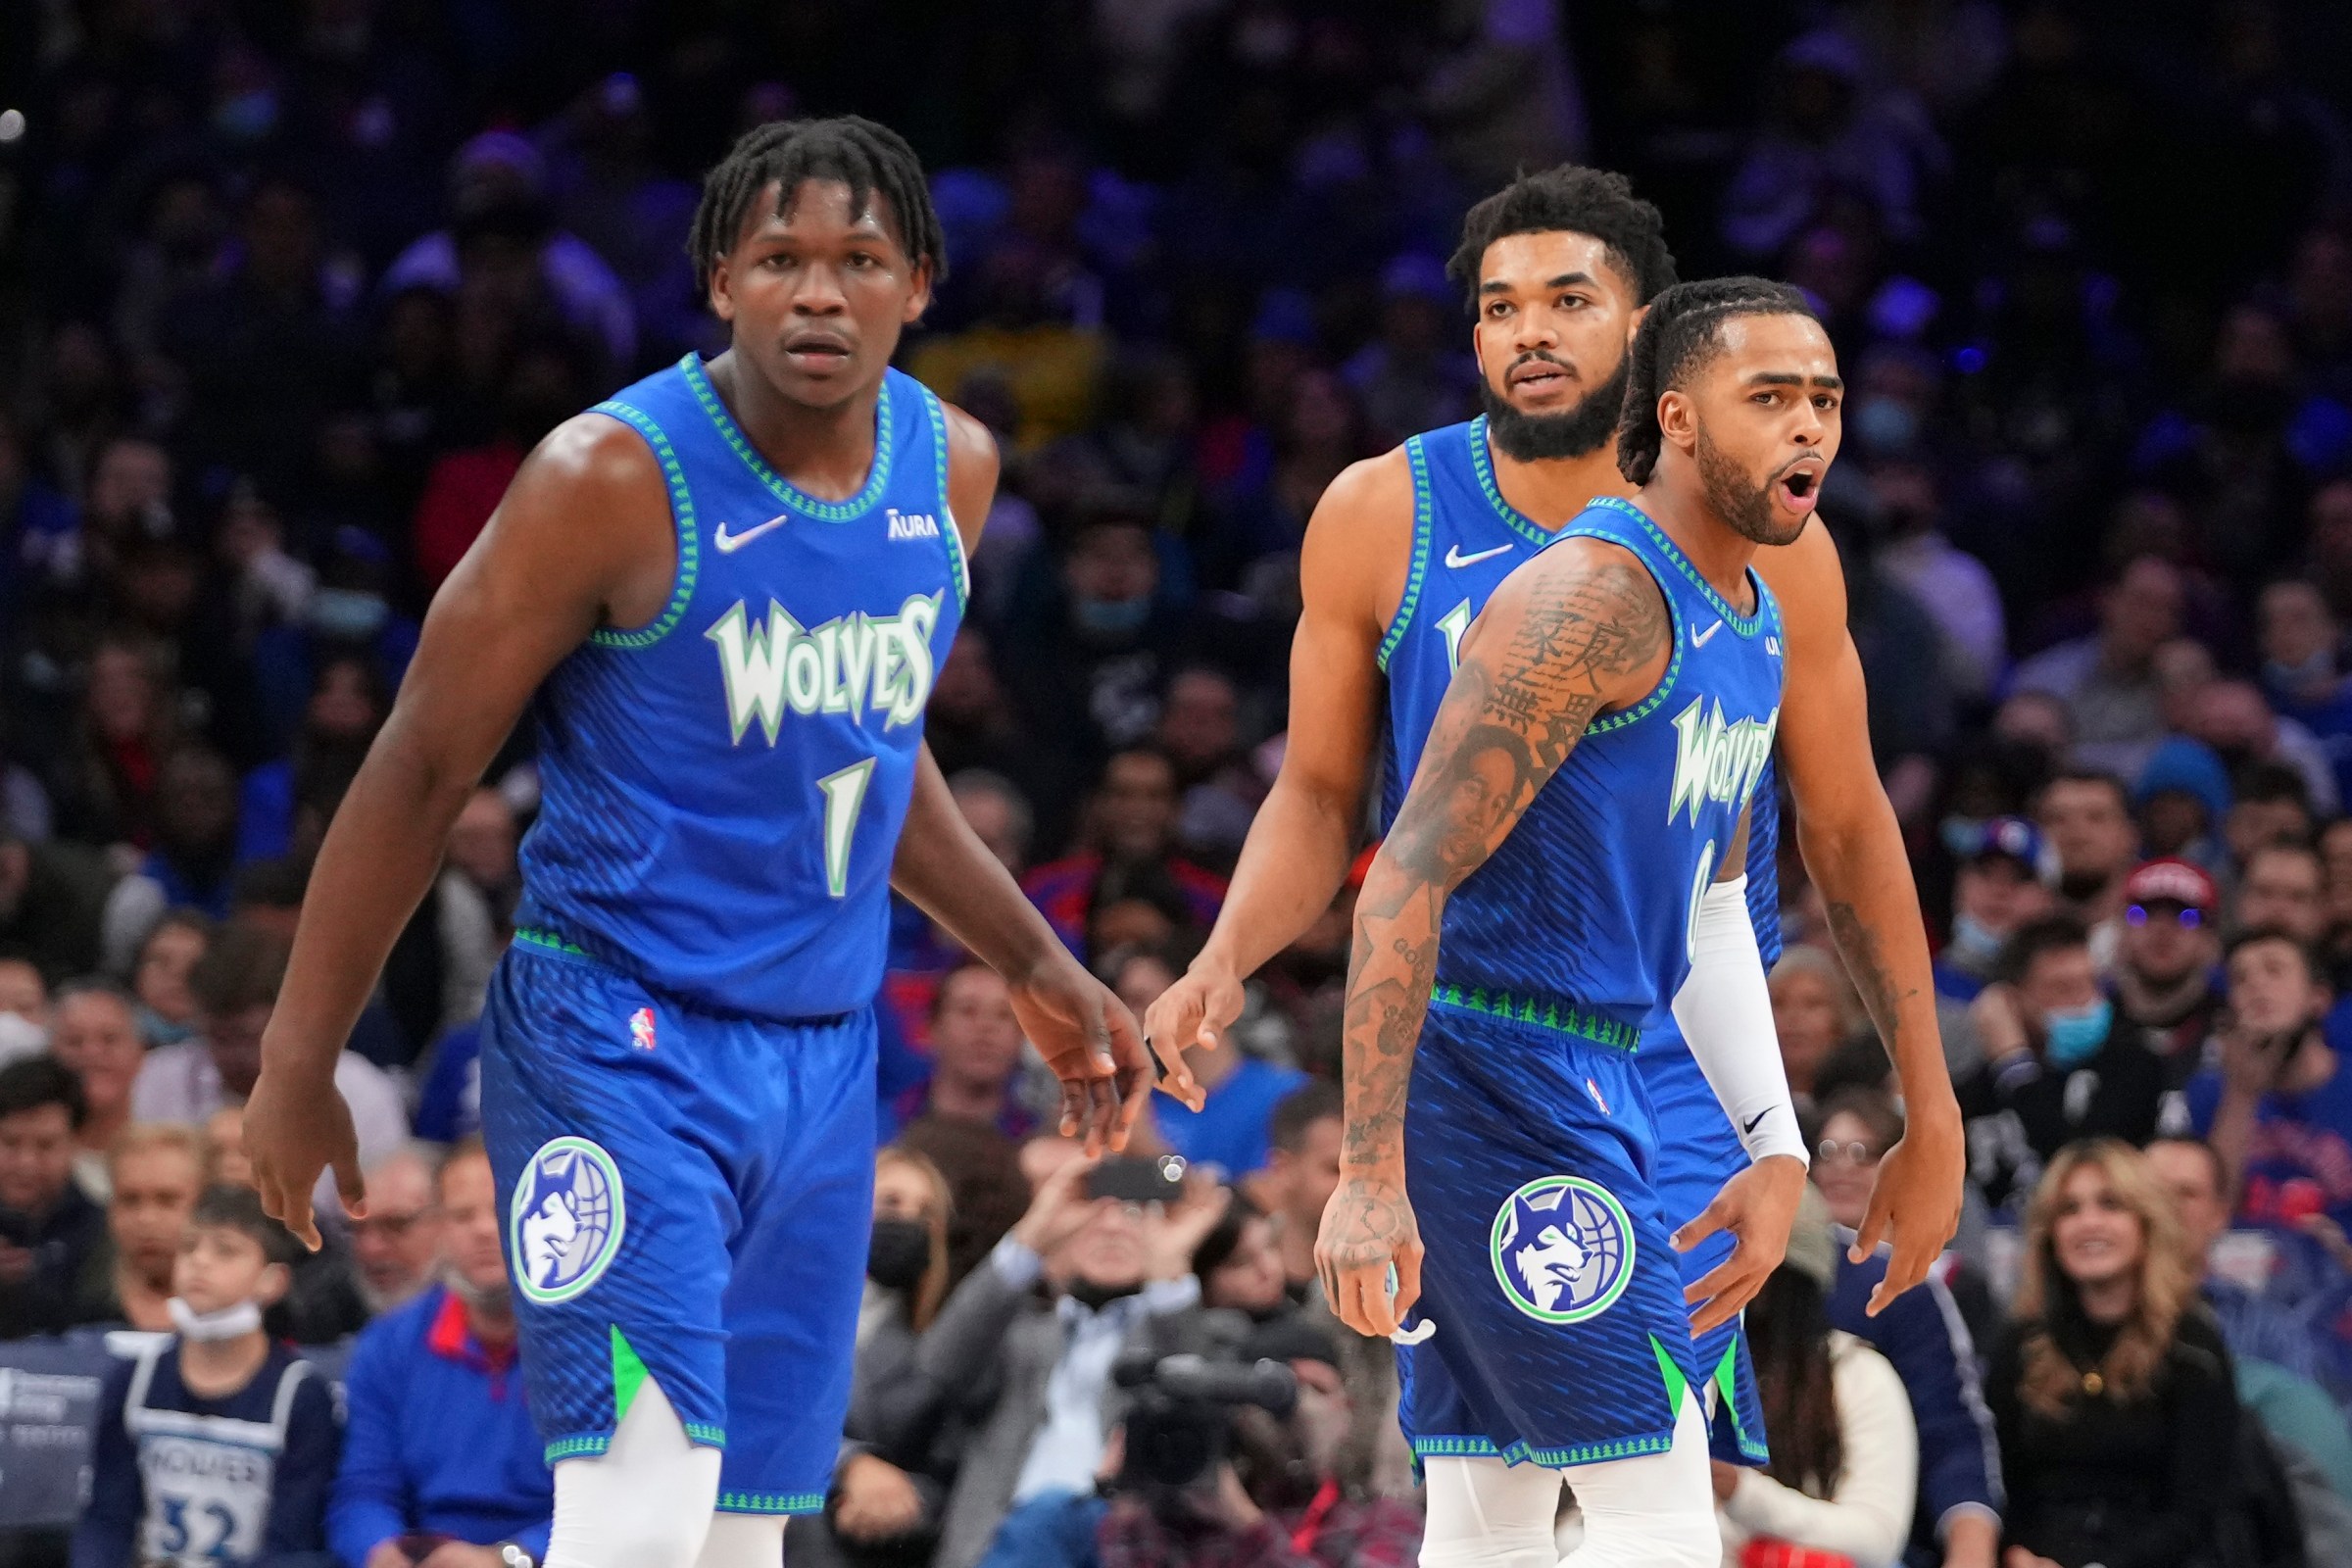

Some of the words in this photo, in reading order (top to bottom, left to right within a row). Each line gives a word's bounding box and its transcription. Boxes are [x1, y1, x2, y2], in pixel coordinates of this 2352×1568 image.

[704, 587, 945, 747] WOLVES
[816, 757, 877, 898] 1
[161, 1494, 237, 1558] 32
